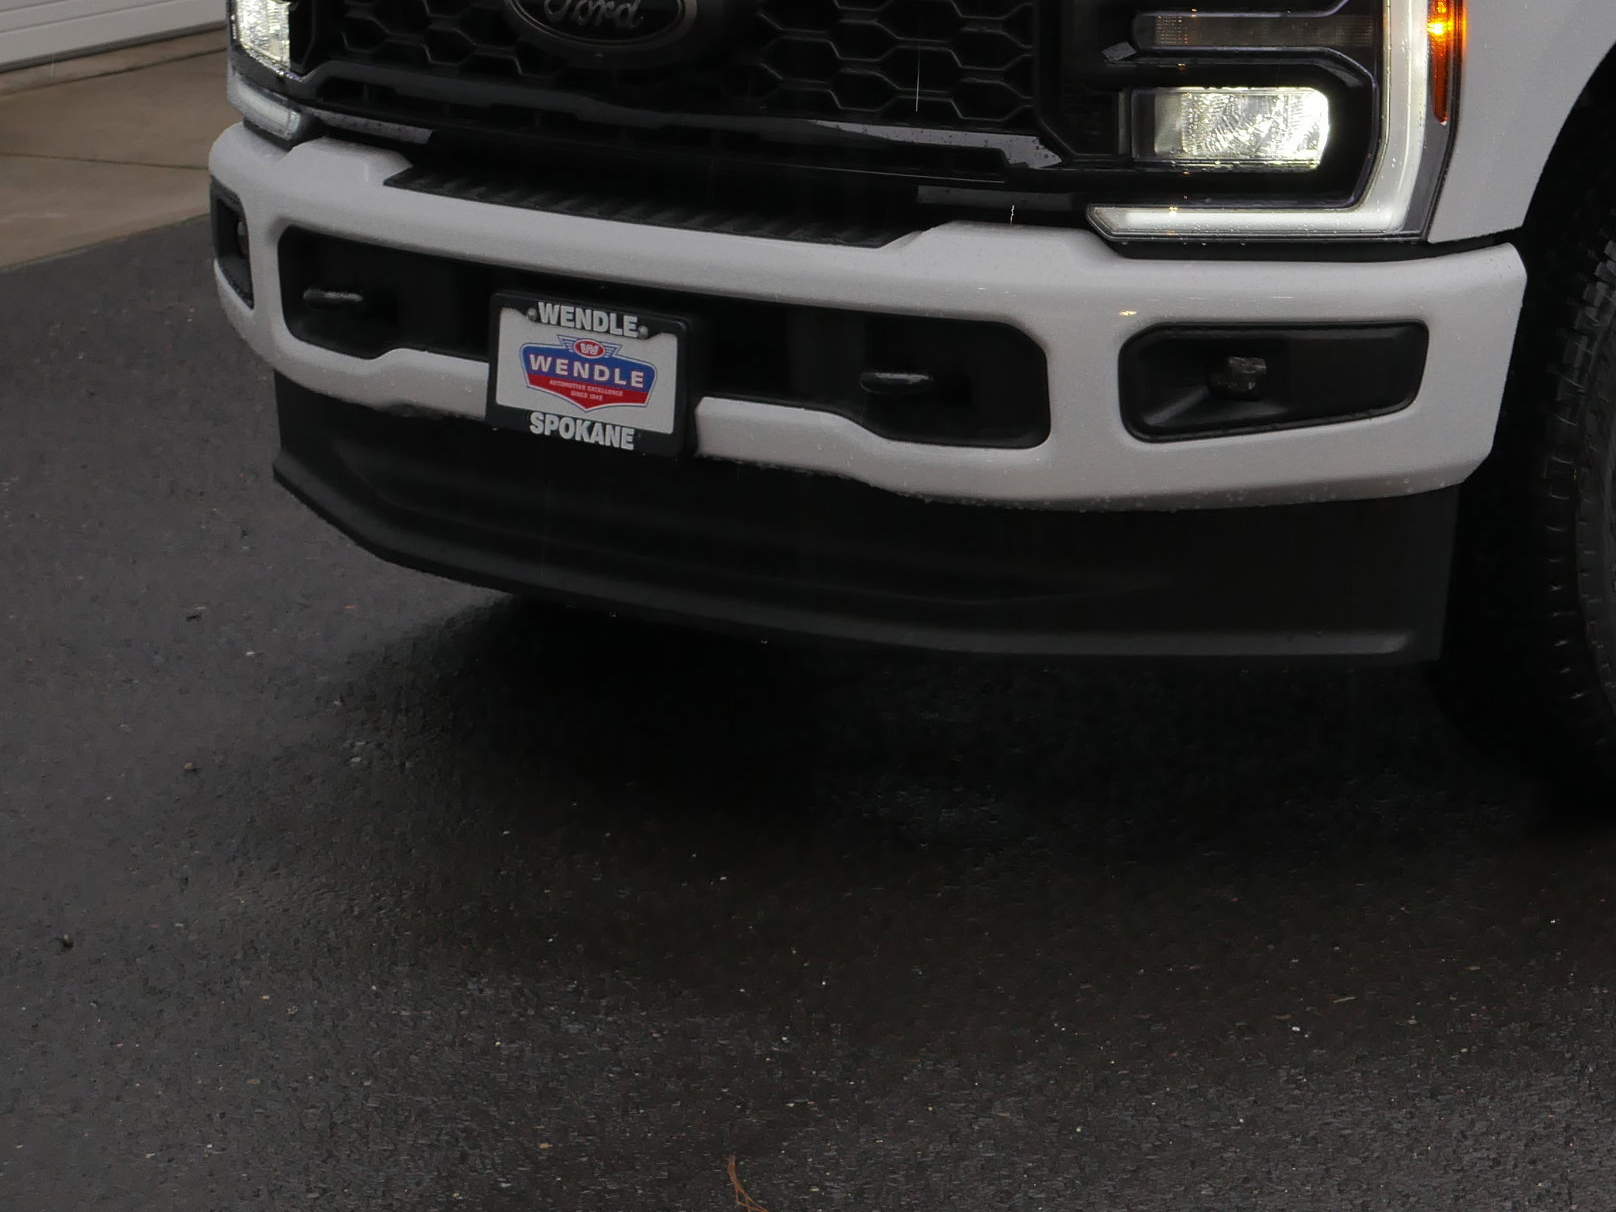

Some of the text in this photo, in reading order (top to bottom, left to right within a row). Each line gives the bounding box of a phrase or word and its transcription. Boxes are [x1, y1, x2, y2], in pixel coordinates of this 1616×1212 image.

[538, 300, 640, 338] WENDLE
[529, 353, 645, 388] WENDLE
[529, 411, 636, 451] SPOKANE
